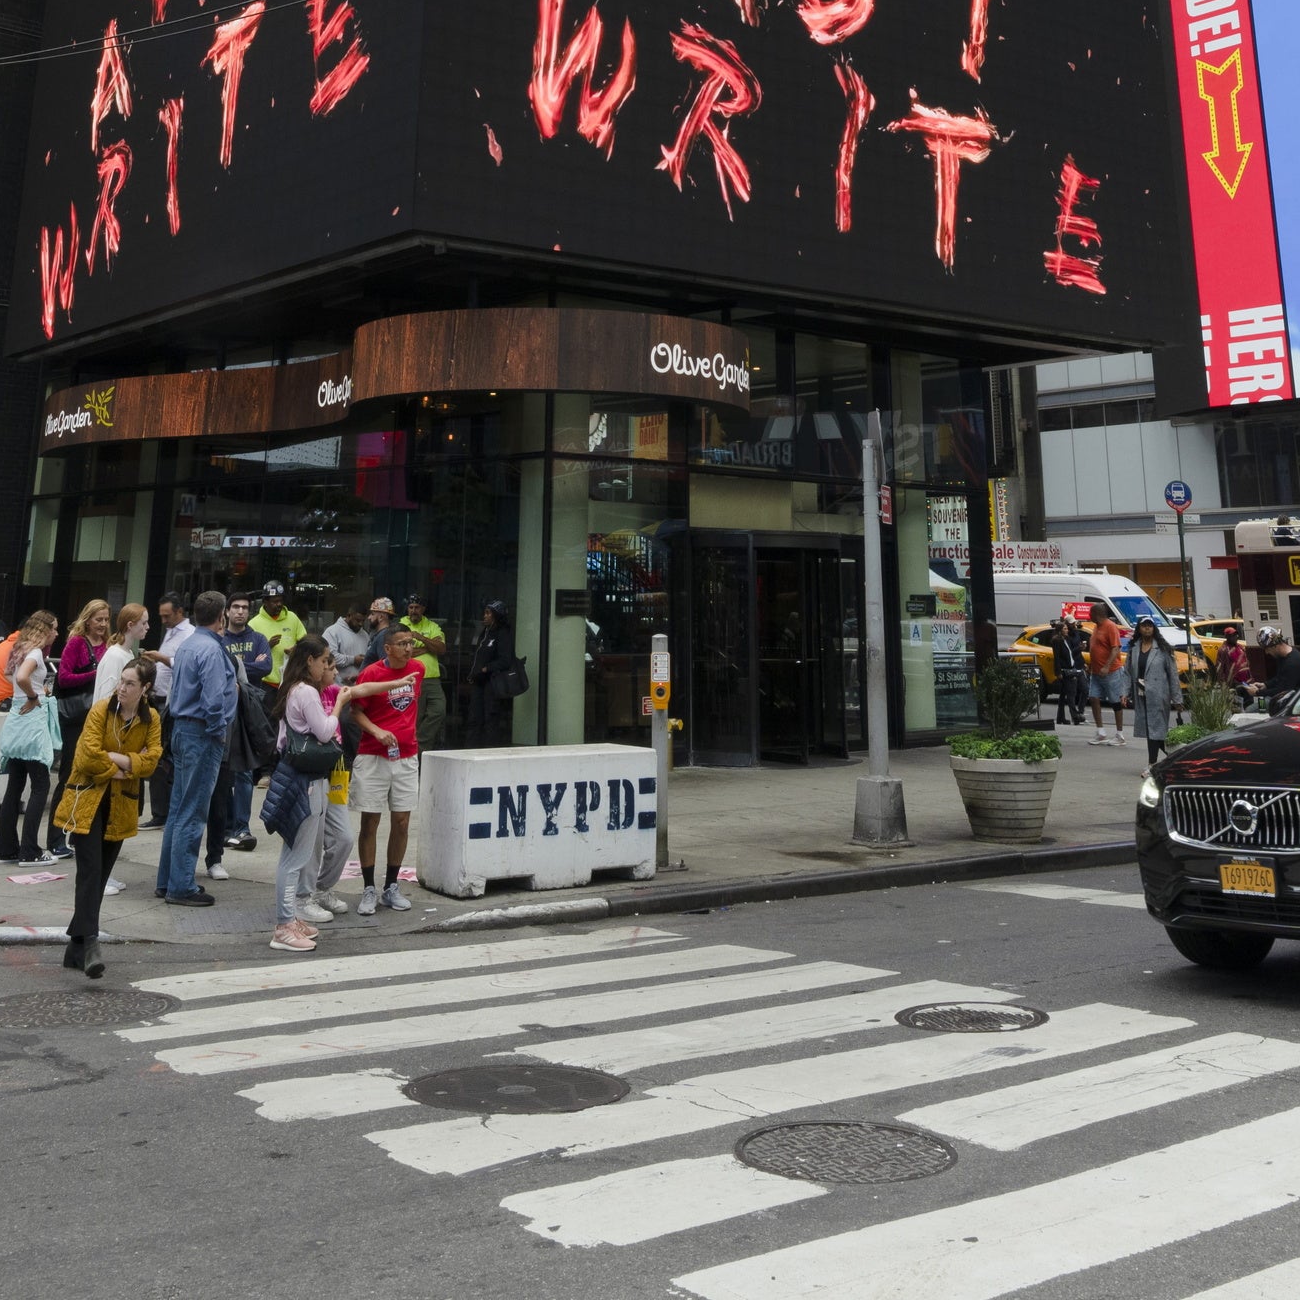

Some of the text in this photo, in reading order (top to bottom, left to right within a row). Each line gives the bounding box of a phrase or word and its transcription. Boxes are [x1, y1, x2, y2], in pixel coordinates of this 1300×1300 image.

[651, 343, 712, 379] Olive
[317, 377, 343, 408] Olive
[58, 409, 92, 439] Garden
[945, 527, 961, 540] THE
[912, 625, 921, 639] A
[496, 778, 636, 839] NYPD
[1223, 866, 1273, 888] T691926C
